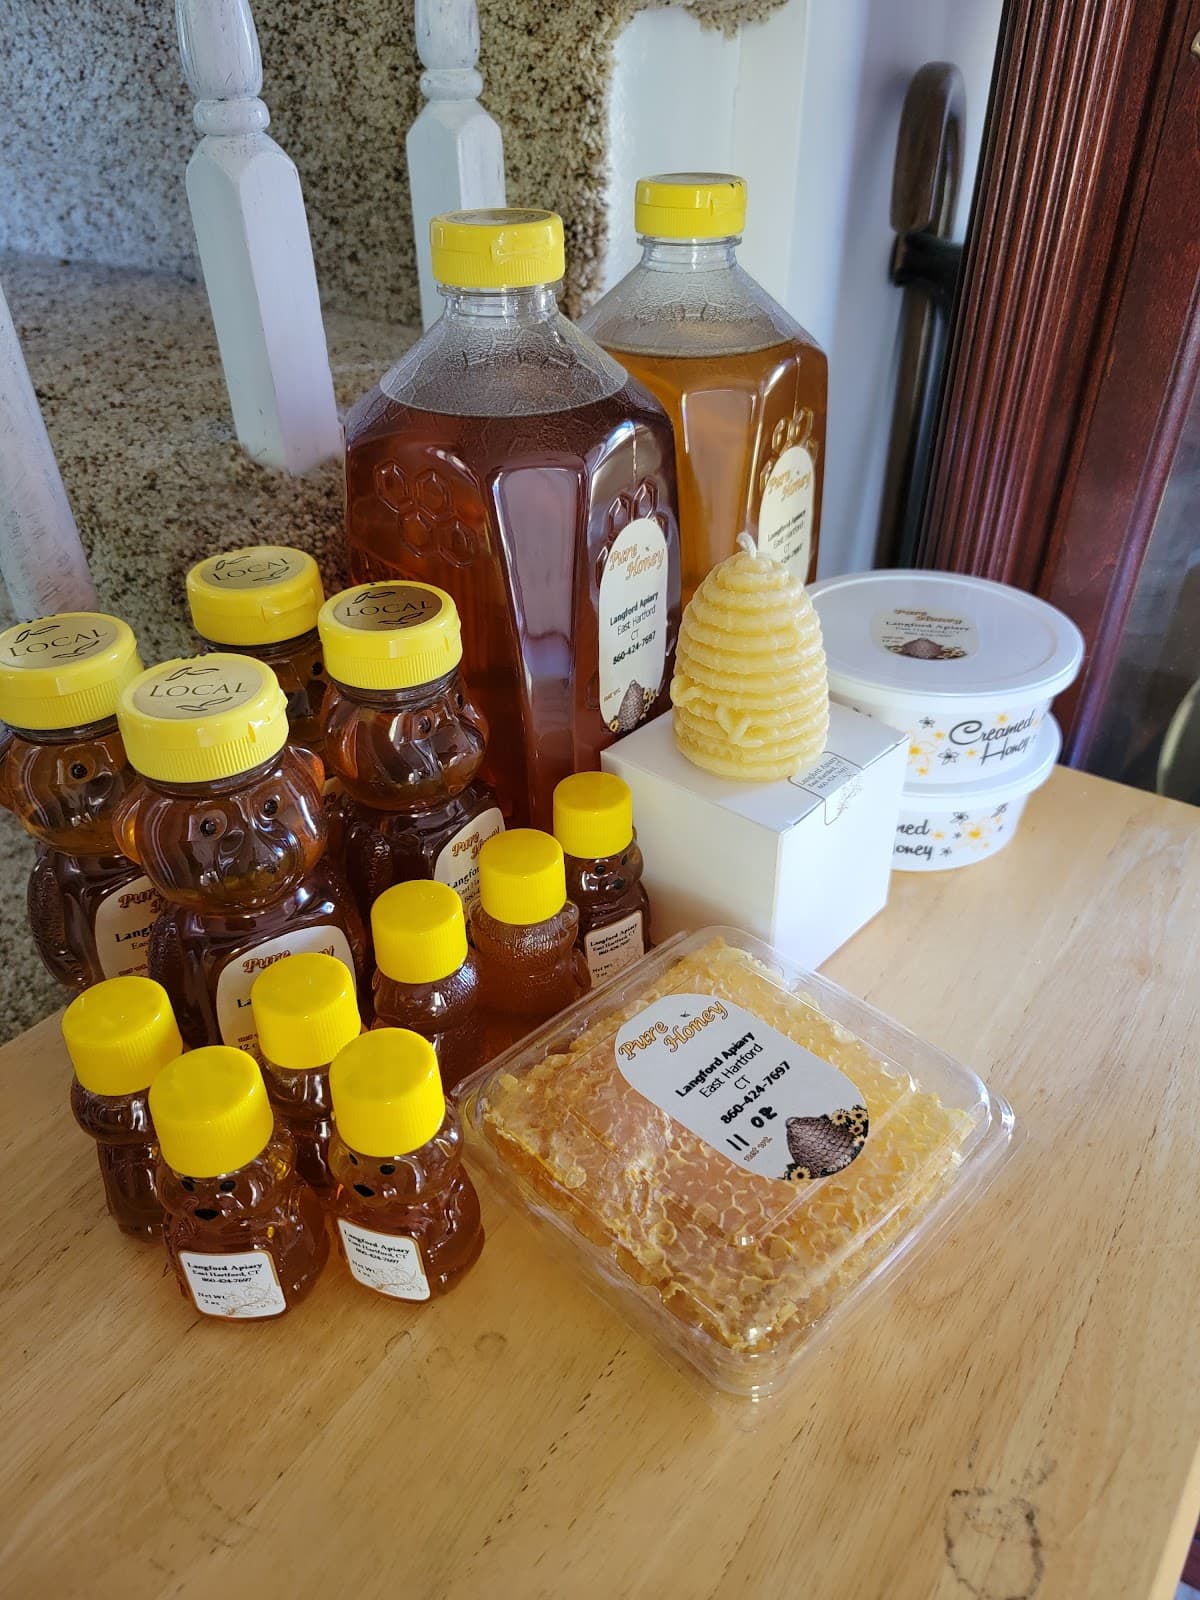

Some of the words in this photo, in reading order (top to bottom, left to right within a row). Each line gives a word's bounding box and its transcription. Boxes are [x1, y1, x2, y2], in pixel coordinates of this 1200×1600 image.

[212, 557, 295, 581] LOCAL
[609, 544, 638, 571] Pure
[625, 548, 664, 580] Honey
[345, 600, 432, 617] LOCAL
[610, 600, 638, 626] Langford
[639, 591, 659, 609] Apiary
[617, 620, 631, 636] East
[632, 604, 657, 627] Hartford
[9, 628, 109, 658] LOCAL
[631, 628, 639, 641] CT
[149, 682, 248, 697] LOCAL
[949, 708, 1036, 745] Creamed
[980, 735, 1035, 766] Honey
[452, 831, 480, 857] Pure
[893, 844, 933, 861] oney
[131, 941, 150, 950] Eas
[618, 1021, 668, 1060] Pure
[664, 1001, 729, 1052] Honey
[675, 1056, 724, 1097] Langford
[720, 1032, 756, 1060] Apiary
[699, 1073, 726, 1098] East
[724, 1043, 764, 1080] Hartford
[720, 1061, 791, 1124] 860-424-7697
[735, 1075, 753, 1090] CT
[344, 1230, 378, 1247] Langford
[381, 1244, 410, 1254] Apiary
[187, 1262, 228, 1271] Langford
[231, 1263, 262, 1272] Apiary
